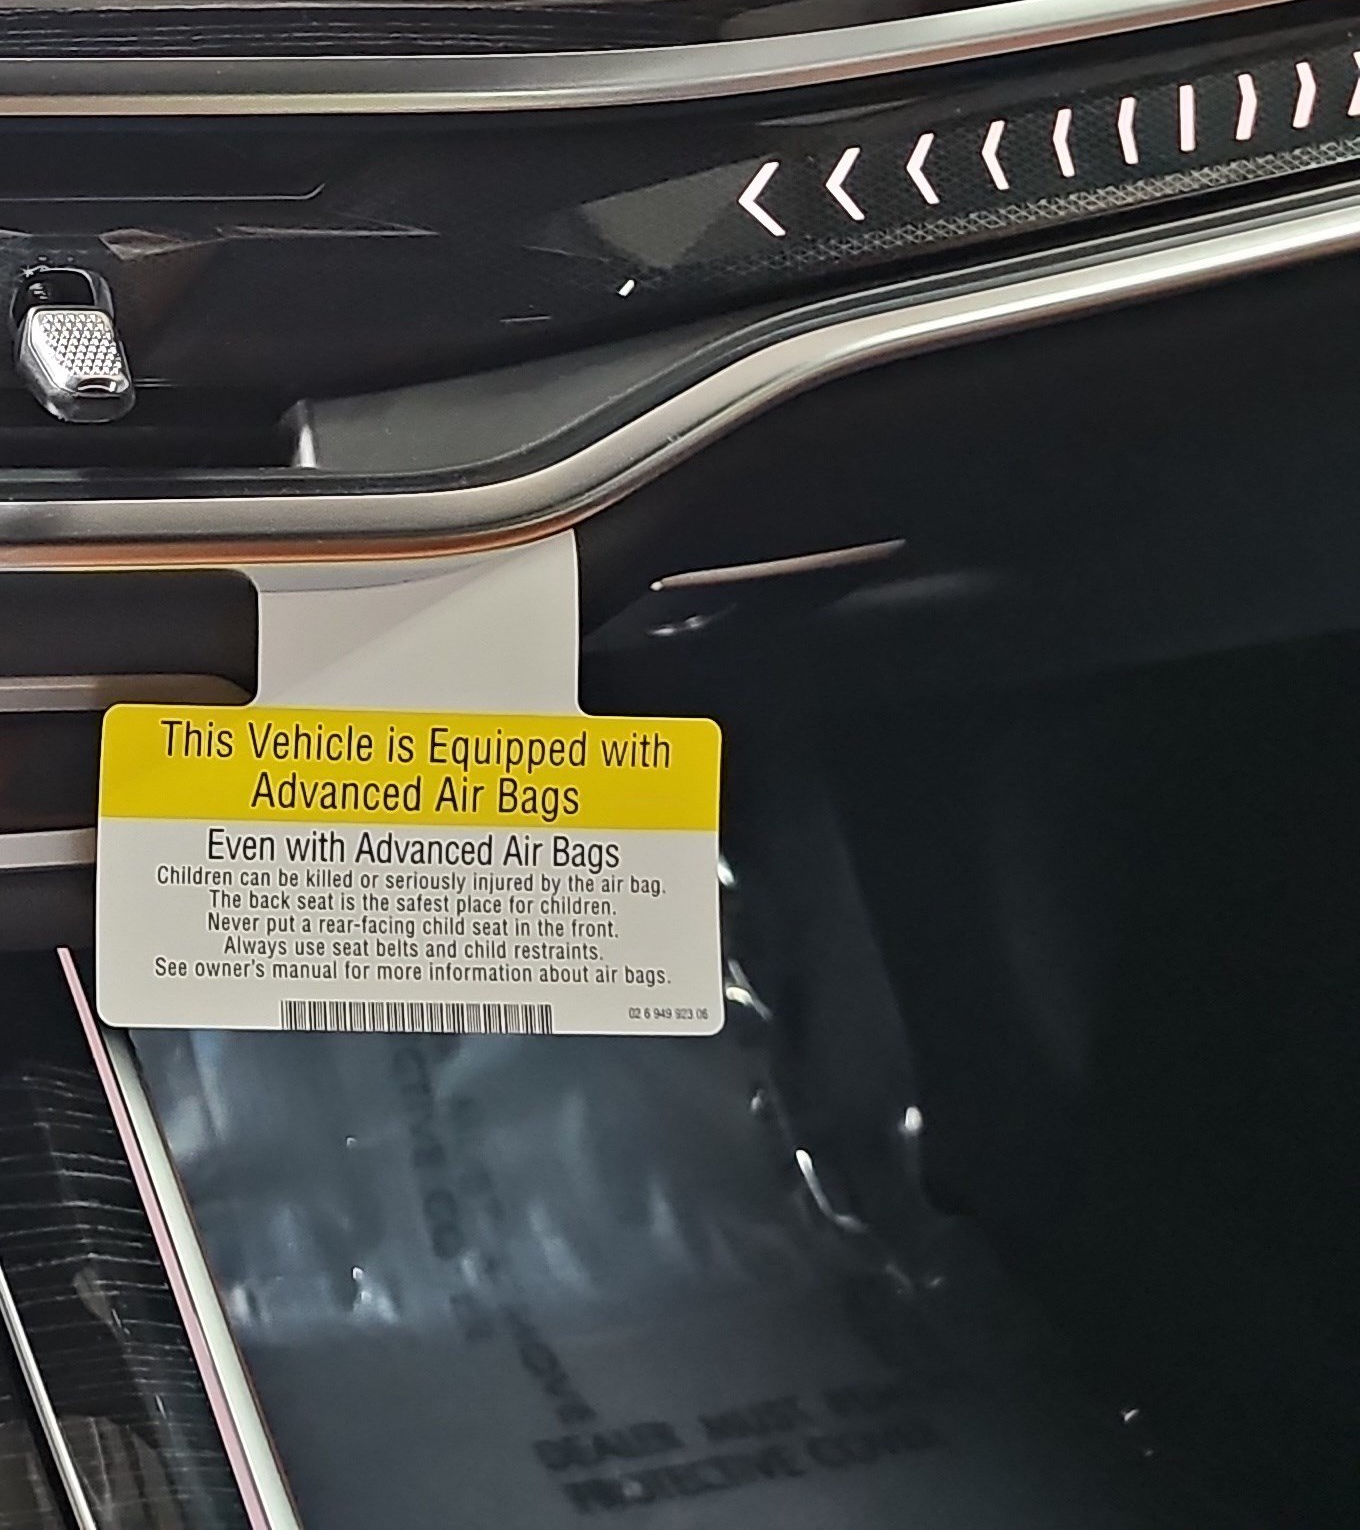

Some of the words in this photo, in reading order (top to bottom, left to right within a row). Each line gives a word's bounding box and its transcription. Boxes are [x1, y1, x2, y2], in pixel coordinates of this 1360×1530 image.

[161, 719, 233, 758] This
[248, 722, 373, 761] Vehicle
[388, 726, 414, 765] is
[430, 727, 587, 774] Equipped
[601, 732, 670, 768] with
[251, 771, 421, 812] Advanced
[435, 776, 485, 813] Air
[498, 778, 579, 822] Bags
[209, 828, 275, 861] Even
[286, 830, 345, 862] with
[355, 831, 493, 866] Advanced
[503, 835, 544, 867] Air
[553, 836, 620, 874] Bags
[157, 865, 232, 886] Children
[240, 871, 270, 887] can
[279, 869, 299, 887] be
[306, 869, 353, 888] killed
[360, 874, 379, 889] or
[385, 872, 466, 894] seriously
[473, 872, 533, 895] injured
[541, 874, 561, 896] by
[568, 875, 595, 893] the
[601, 875, 624, 894] air
[630, 875, 666, 897] bag.
[209, 889, 241, 908] The
[249, 890, 290, 909] back
[297, 892, 333, 910] seat
[341, 892, 355, 911] is
[362, 893, 389, 911] the
[396, 894, 449, 913] safest
[456, 895, 501, 916] place
[509, 895, 533, 914] for
[540, 896, 617, 916] children.
[208, 912, 259, 931] Never
[267, 915, 295, 936] put
[302, 918, 311, 933] a
[319, 915, 415, 938] rear-facing
[423, 916, 465, 936] child
[472, 918, 508, 936] seat
[515, 917, 531, 937] in
[538, 918, 564, 937] the
[571, 918, 619, 938] front.
[224, 935, 287, 959] Always
[295, 940, 325, 956] use
[332, 938, 369, 957] seat
[376, 938, 418, 958] belts
[425, 940, 457, 958] and
[464, 940, 506, 959] child
[514, 941, 603, 961] restraints.
[155, 956, 187, 977] See
[195, 958, 265, 978] owner's
[272, 960, 337, 979] manual
[344, 960, 369, 979] for
[377, 964, 422, 980] more
[429, 962, 532, 982] information
[539, 964, 588, 983] about
[595, 965, 618, 983] air
[625, 965, 672, 988] bags.
[628, 1007, 641, 1019] 02
[644, 1007, 651, 1019] 6
